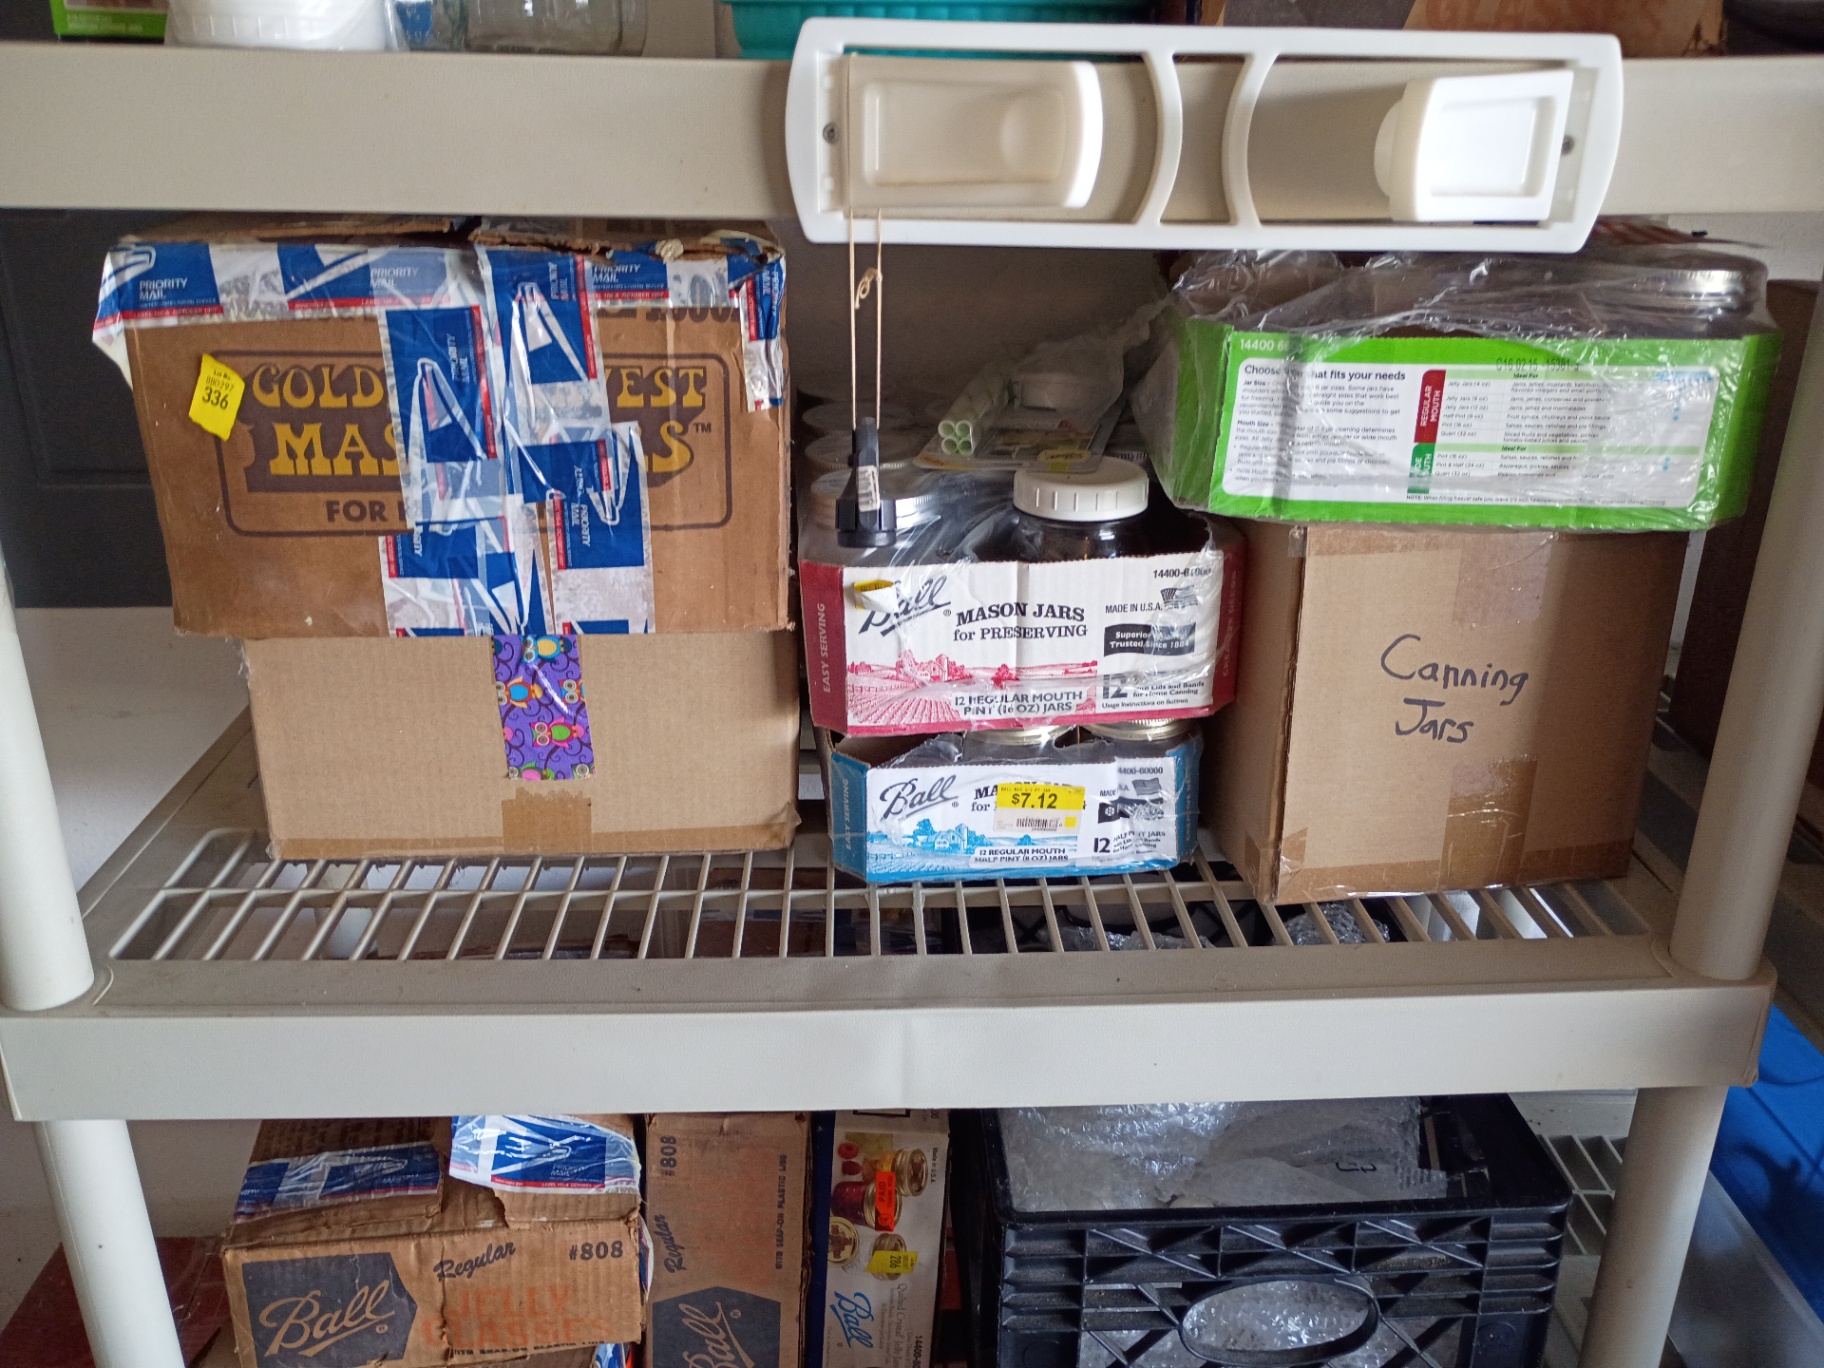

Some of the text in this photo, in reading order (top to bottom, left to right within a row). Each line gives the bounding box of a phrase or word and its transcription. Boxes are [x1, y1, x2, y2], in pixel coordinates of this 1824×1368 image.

[140, 277, 188, 291] PRIORITY
[371, 267, 419, 278] PRIORITY
[1240, 338, 1275, 351] 14400
[252, 364, 385, 409] GOLD
[1330, 369, 1346, 379] fits
[1348, 370, 1373, 382] your
[1375, 370, 1406, 380] needs
[202, 386, 229, 410] 336
[1420, 385, 1433, 428] REGULAR
[1430, 389, 1442, 423] MOUTH
[1237, 419, 1256, 427] Mouth
[326, 499, 389, 523] FOR
[955, 601, 1086, 627] MASON JARS
[1105, 601, 1163, 614] MADE IN U.S.A.
[953, 624, 1088, 642] for PRESERVING
[1109, 640, 1145, 649] Trusted
[816, 602, 832, 694] EASY SERVING
[1380, 633, 1529, 706] Canning
[954, 690, 1083, 707] 12 REGULAR MOUTH
[1102, 674, 1128, 700] 12
[1169, 688, 1199, 697] Canning
[1042, 701, 1073, 714] JARS
[1101, 702, 1120, 710] Usage
[1395, 697, 1474, 744] Jars
[842, 778, 851, 822] SERVING
[880, 774, 959, 822] Ball
[971, 801, 991, 813] for
[1011, 792, 1058, 810] $7.12
[1093, 837, 1111, 854] 12
[1147, 830, 1166, 838] JARS
[988, 848, 1030, 856] REGULAR
[1031, 847, 1066, 855] MOUTH
[660, 1135, 677, 1177] #808
[931, 1147, 939, 1162] Made
[777, 1175, 787, 1209] PLASTIC
[878, 1180, 887, 1203] PAID
[653, 1213, 688, 1274] Regular
[432, 1239, 624, 1283] Regular #808
[446, 1284, 572, 1320] JELLY
[897, 1282, 908, 1311] Quilted
[259, 1279, 396, 1357] Ball
[830, 1291, 875, 1349] Ball
